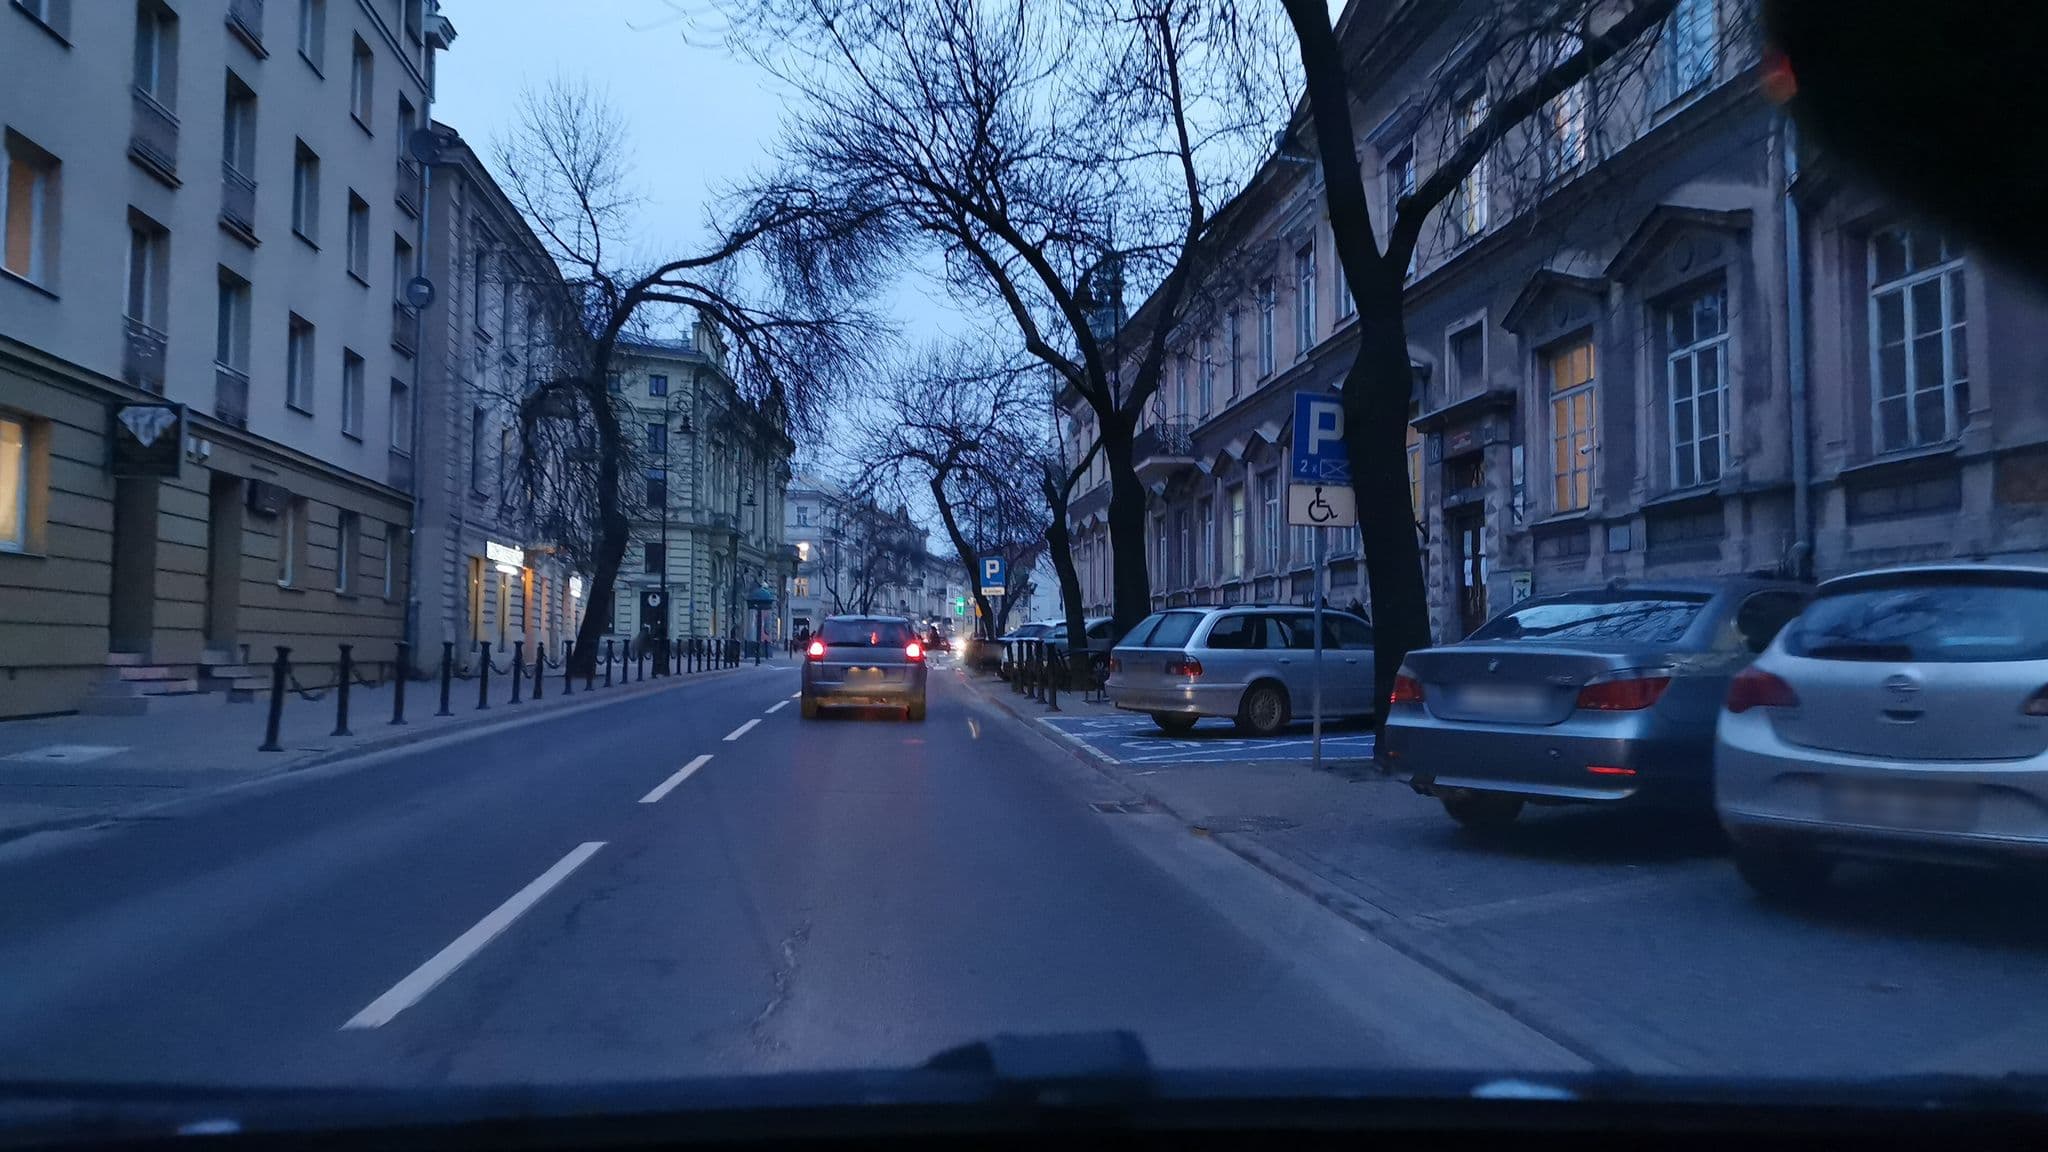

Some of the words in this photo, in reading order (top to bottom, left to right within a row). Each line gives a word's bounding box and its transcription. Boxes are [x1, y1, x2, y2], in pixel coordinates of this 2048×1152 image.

[1308, 401, 1345, 455] P
[1300, 460, 1308, 473] 2
[985, 559, 1000, 579] P
